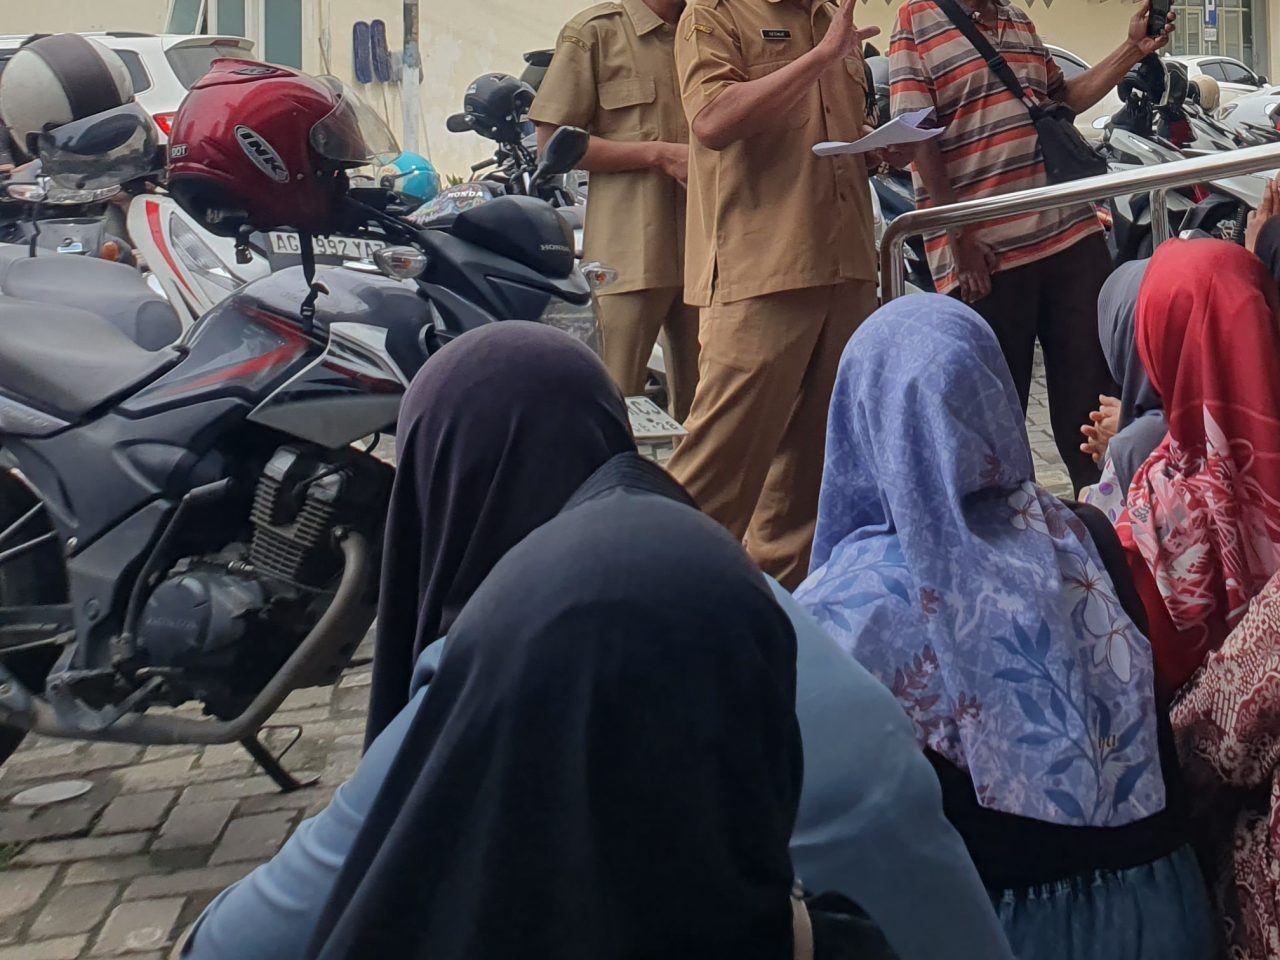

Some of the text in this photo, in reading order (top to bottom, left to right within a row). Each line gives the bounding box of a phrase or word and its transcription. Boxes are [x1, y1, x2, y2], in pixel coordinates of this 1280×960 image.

[171, 145, 187, 157] DOT
[240, 132, 287, 175] INK
[447, 190, 484, 199] HONDA
[275, 234, 299, 252] AG
[540, 244, 570, 253] HONDA
